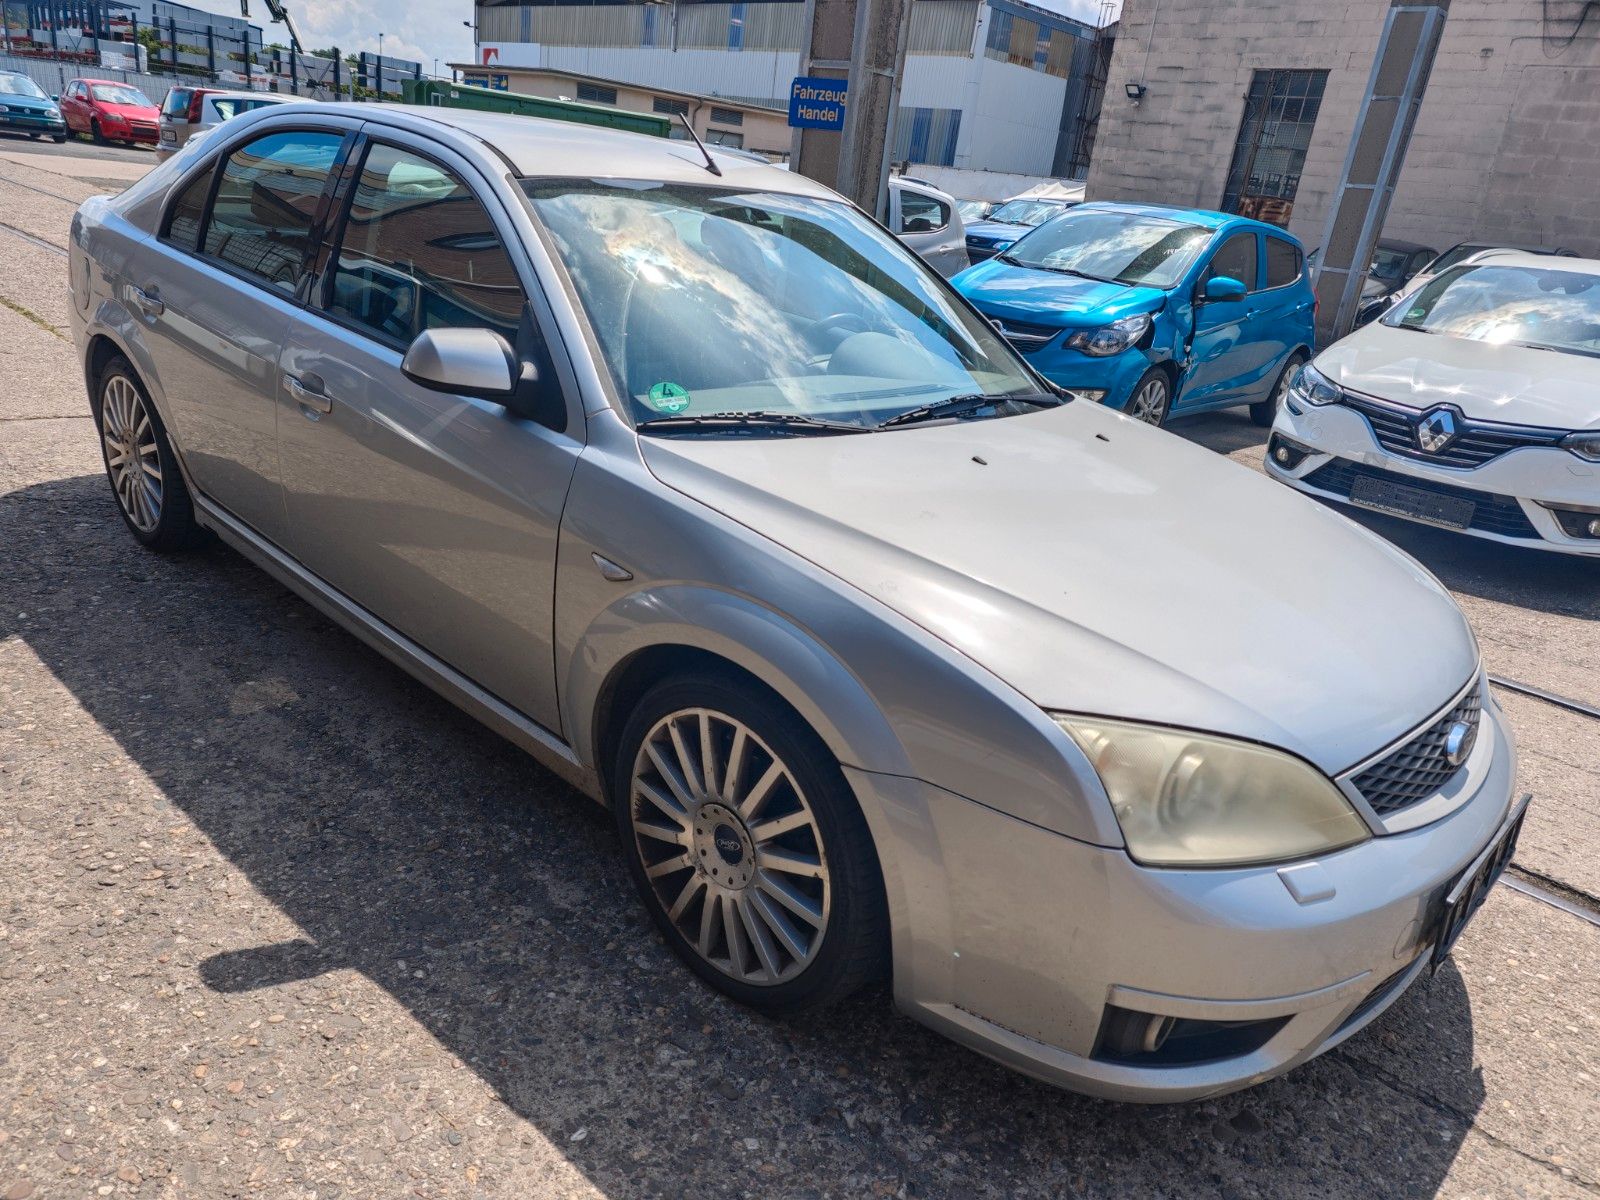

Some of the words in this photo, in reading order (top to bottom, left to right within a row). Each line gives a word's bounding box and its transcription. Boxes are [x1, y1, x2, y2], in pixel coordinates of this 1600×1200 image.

[793, 84, 848, 106] Fahrzeug
[797, 104, 839, 122] Handel
[663, 384, 674, 397] 4
